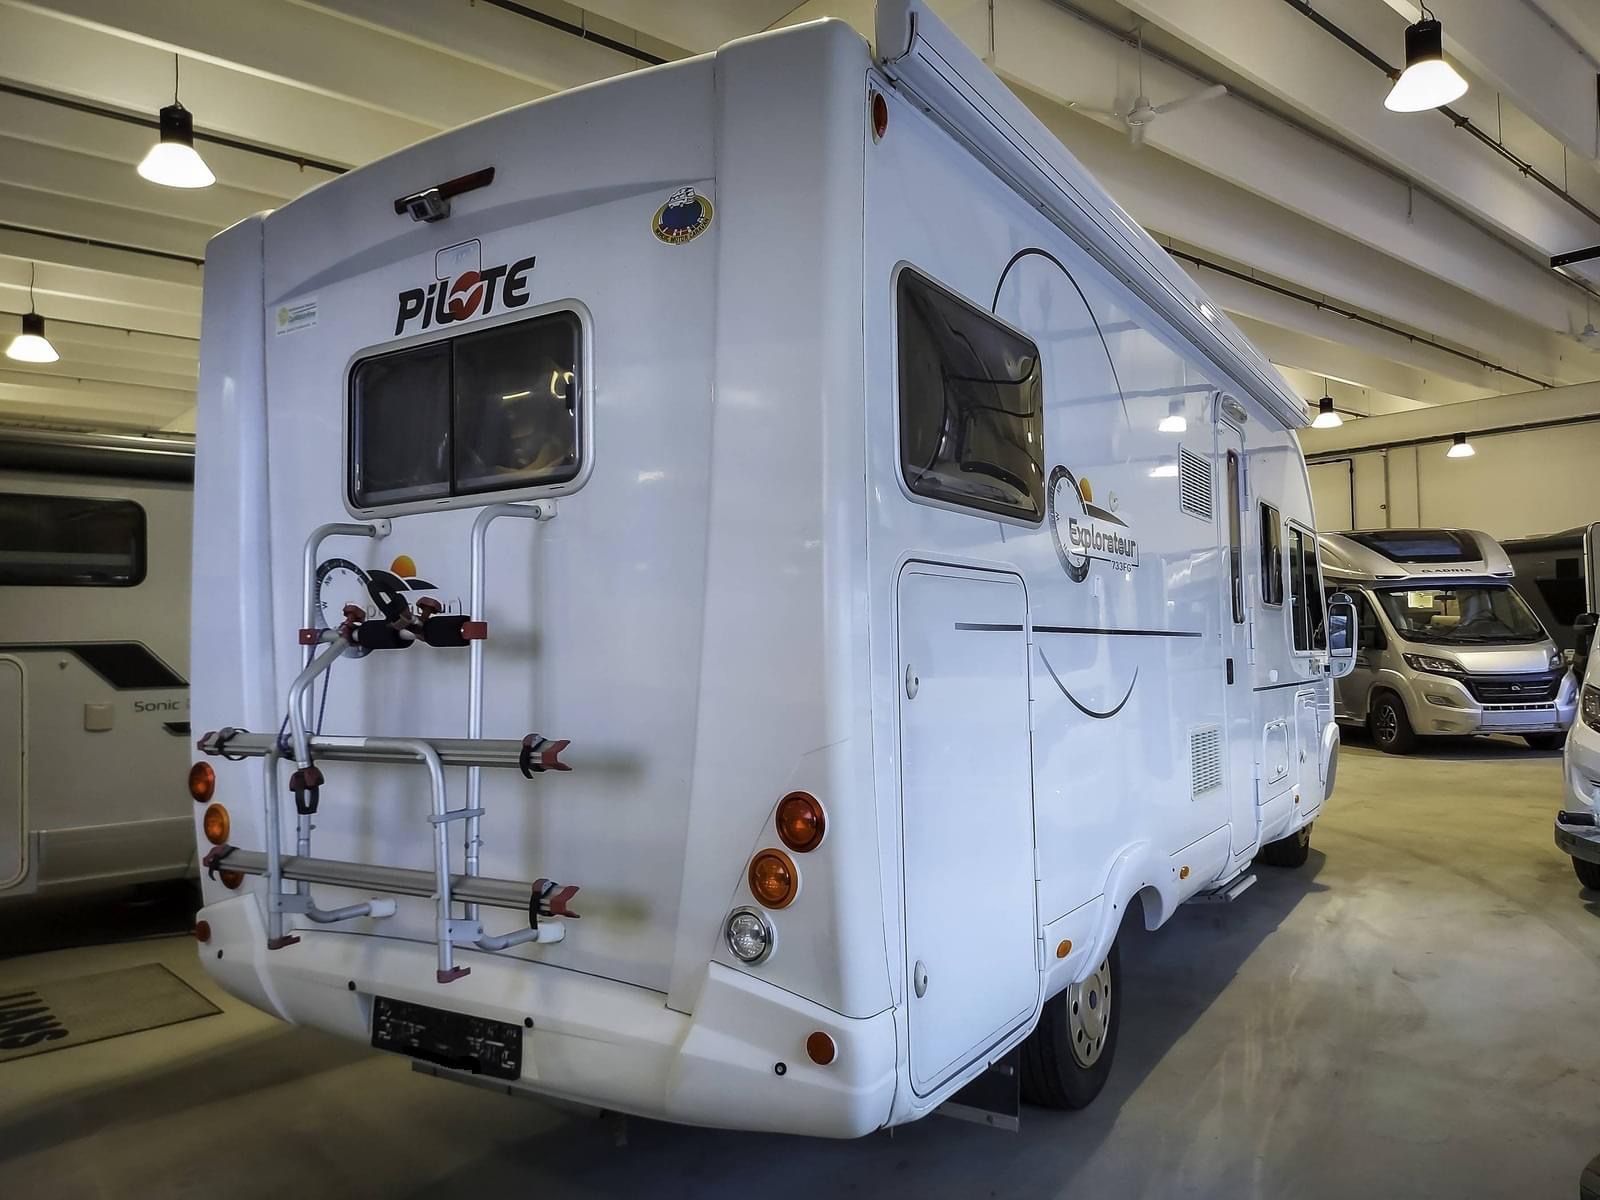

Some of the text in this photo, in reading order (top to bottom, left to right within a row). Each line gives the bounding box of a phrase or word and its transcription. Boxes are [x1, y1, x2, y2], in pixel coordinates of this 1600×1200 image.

[1069, 517, 1136, 557] Explorateur
[1111, 560, 1132, 573] 733FG
[134, 699, 180, 713] Sonic
